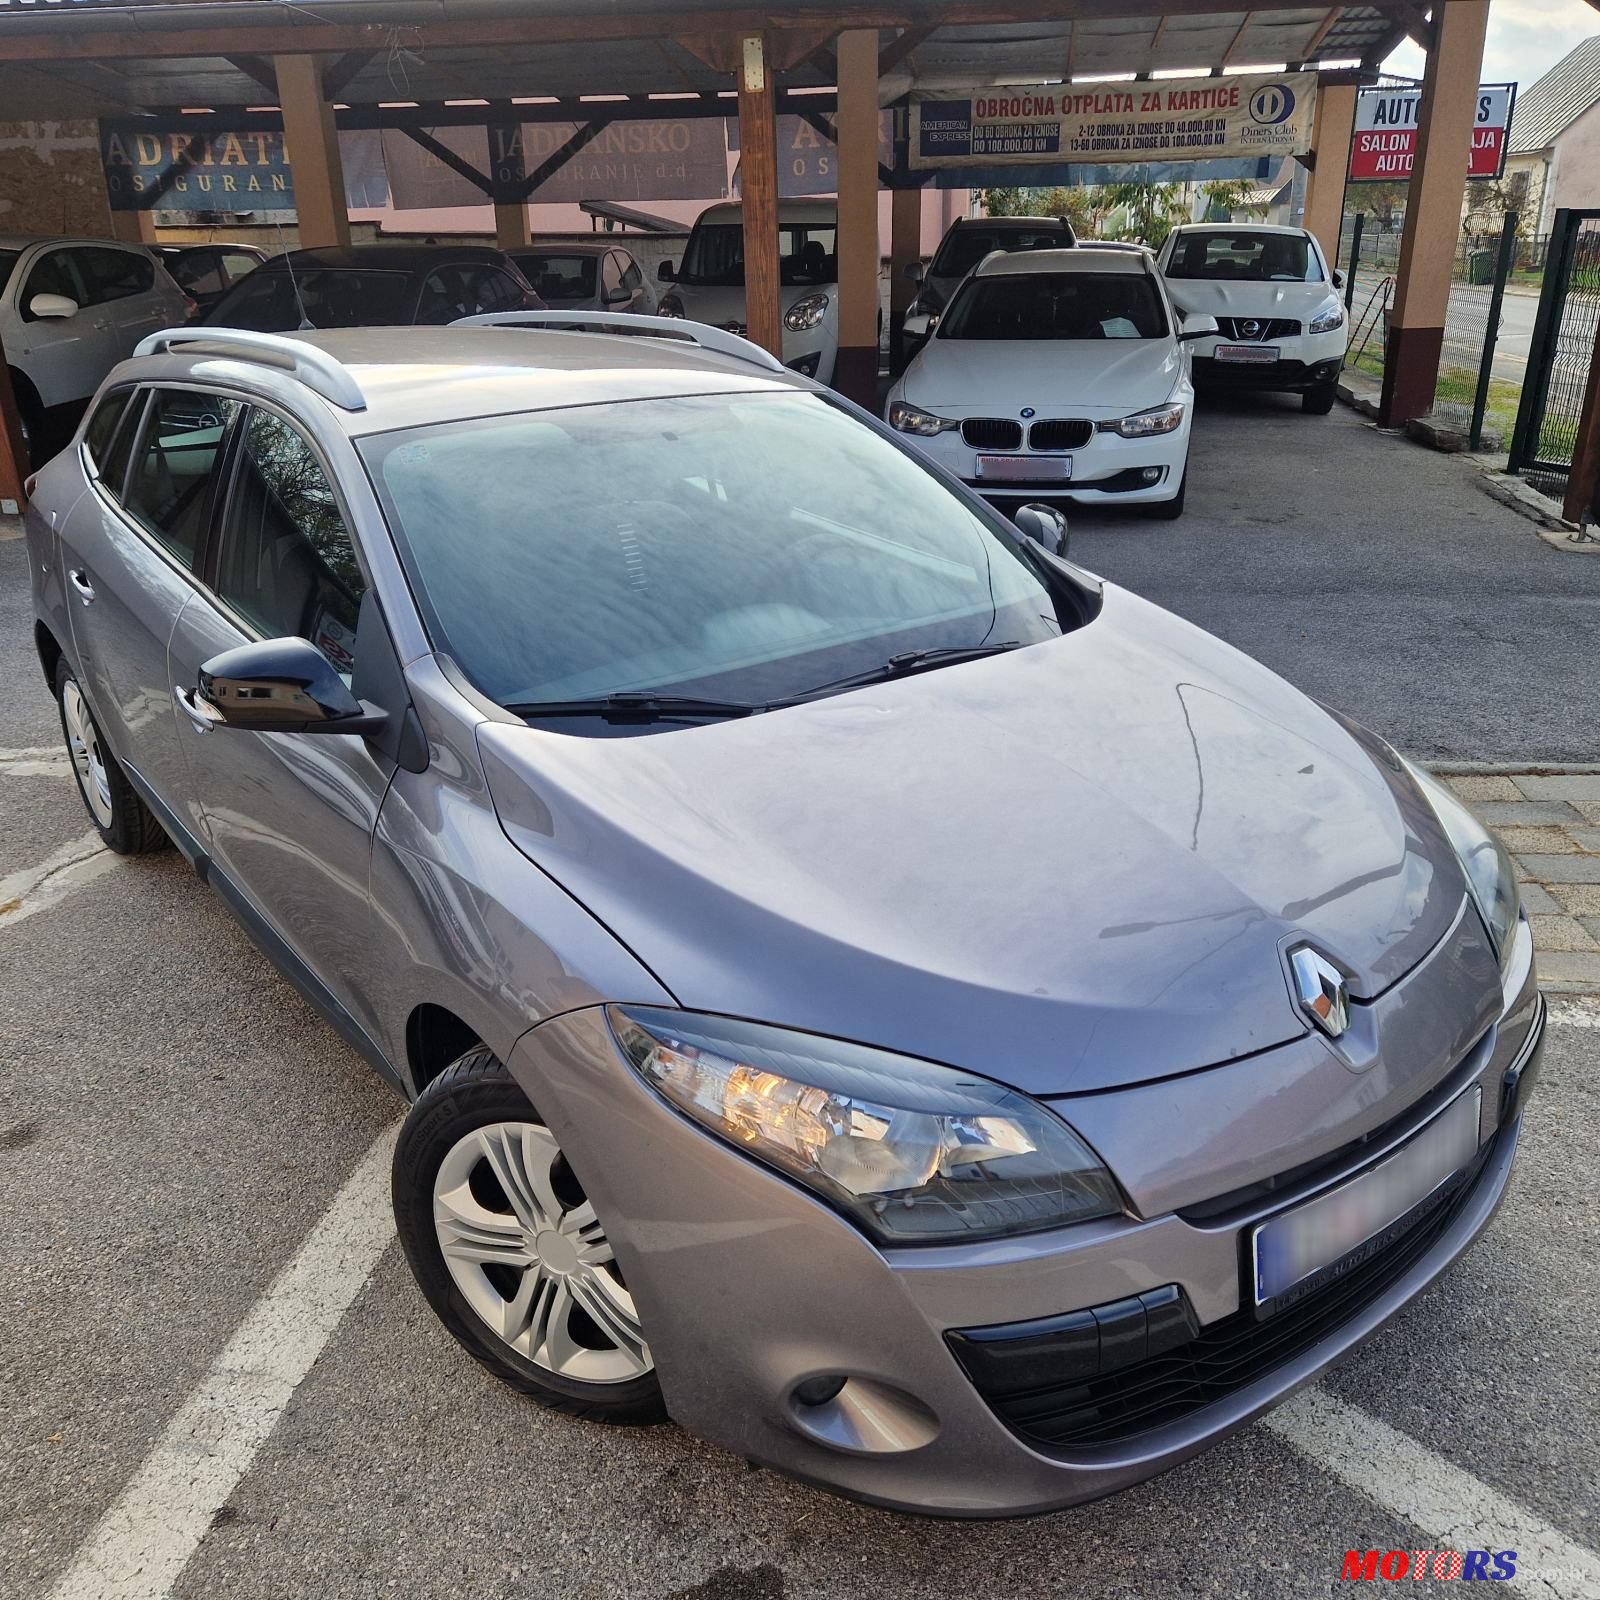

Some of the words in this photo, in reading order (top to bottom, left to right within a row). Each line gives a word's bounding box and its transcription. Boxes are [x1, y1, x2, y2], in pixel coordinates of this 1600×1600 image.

[975, 91, 1055, 118] OBROČNA
[1061, 93, 1134, 115] OTPLATA
[1140, 92, 1162, 112] ZA
[1167, 87, 1240, 111] KARTICE
[920, 120, 967, 130] AMERICAN
[974, 126, 984, 138] DO
[995, 125, 1022, 138] OBROKA
[1023, 125, 1033, 137] ZA
[1034, 124, 1059, 137] IZNOSE
[1079, 124, 1095, 137] 2-12
[1096, 123, 1125, 137] OBROKA
[1126, 123, 1136, 136] ZA
[1137, 122, 1163, 135] IZNOSE
[1165, 121, 1175, 134] DO
[1215, 118, 1226, 131] KN
[1241, 126, 1273, 137] Diners
[1274, 124, 1298, 135] Club
[930, 131, 971, 141] EXPRESS
[1091, 138, 1119, 150] OBROKA
[1121, 138, 1131, 149] ZA
[1132, 136, 1158, 149] IZNOSE
[1160, 135, 1170, 148] DO
[1214, 133, 1225, 145] KN
[1360, 134, 1411, 152] SALON
[106, 132, 290, 167] ADRIATI
[973, 140, 985, 152] DO
[1034, 138, 1047, 151] KN
[1376, 153, 1414, 171] AUTO
[109, 174, 286, 193] OSIGURAN
